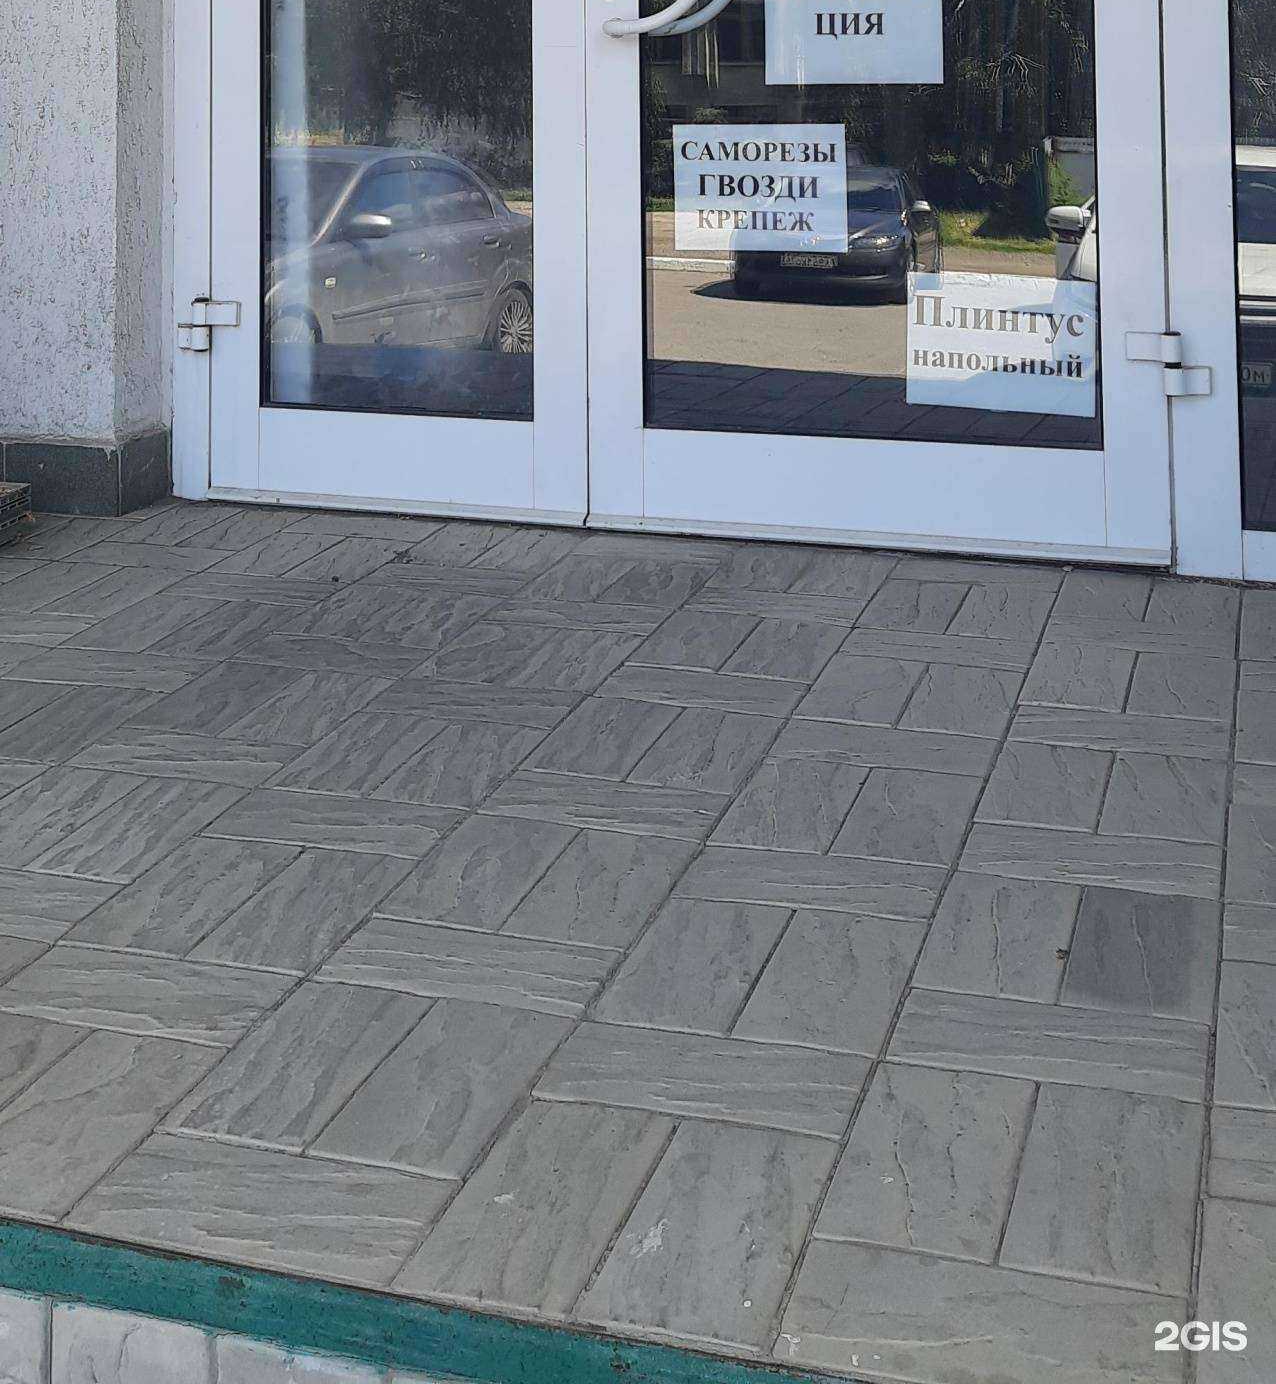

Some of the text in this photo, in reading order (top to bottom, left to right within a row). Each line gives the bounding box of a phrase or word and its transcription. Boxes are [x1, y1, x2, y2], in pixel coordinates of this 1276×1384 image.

[815, 12, 884, 41] ЦИЯ
[680, 139, 838, 164] САМОРЕЗЫ
[697, 173, 820, 202] ГВОЗДИ
[696, 208, 815, 233] КРЕПЕЖ
[913, 293, 1085, 345] Плинтус
[912, 347, 1084, 380] напольный
